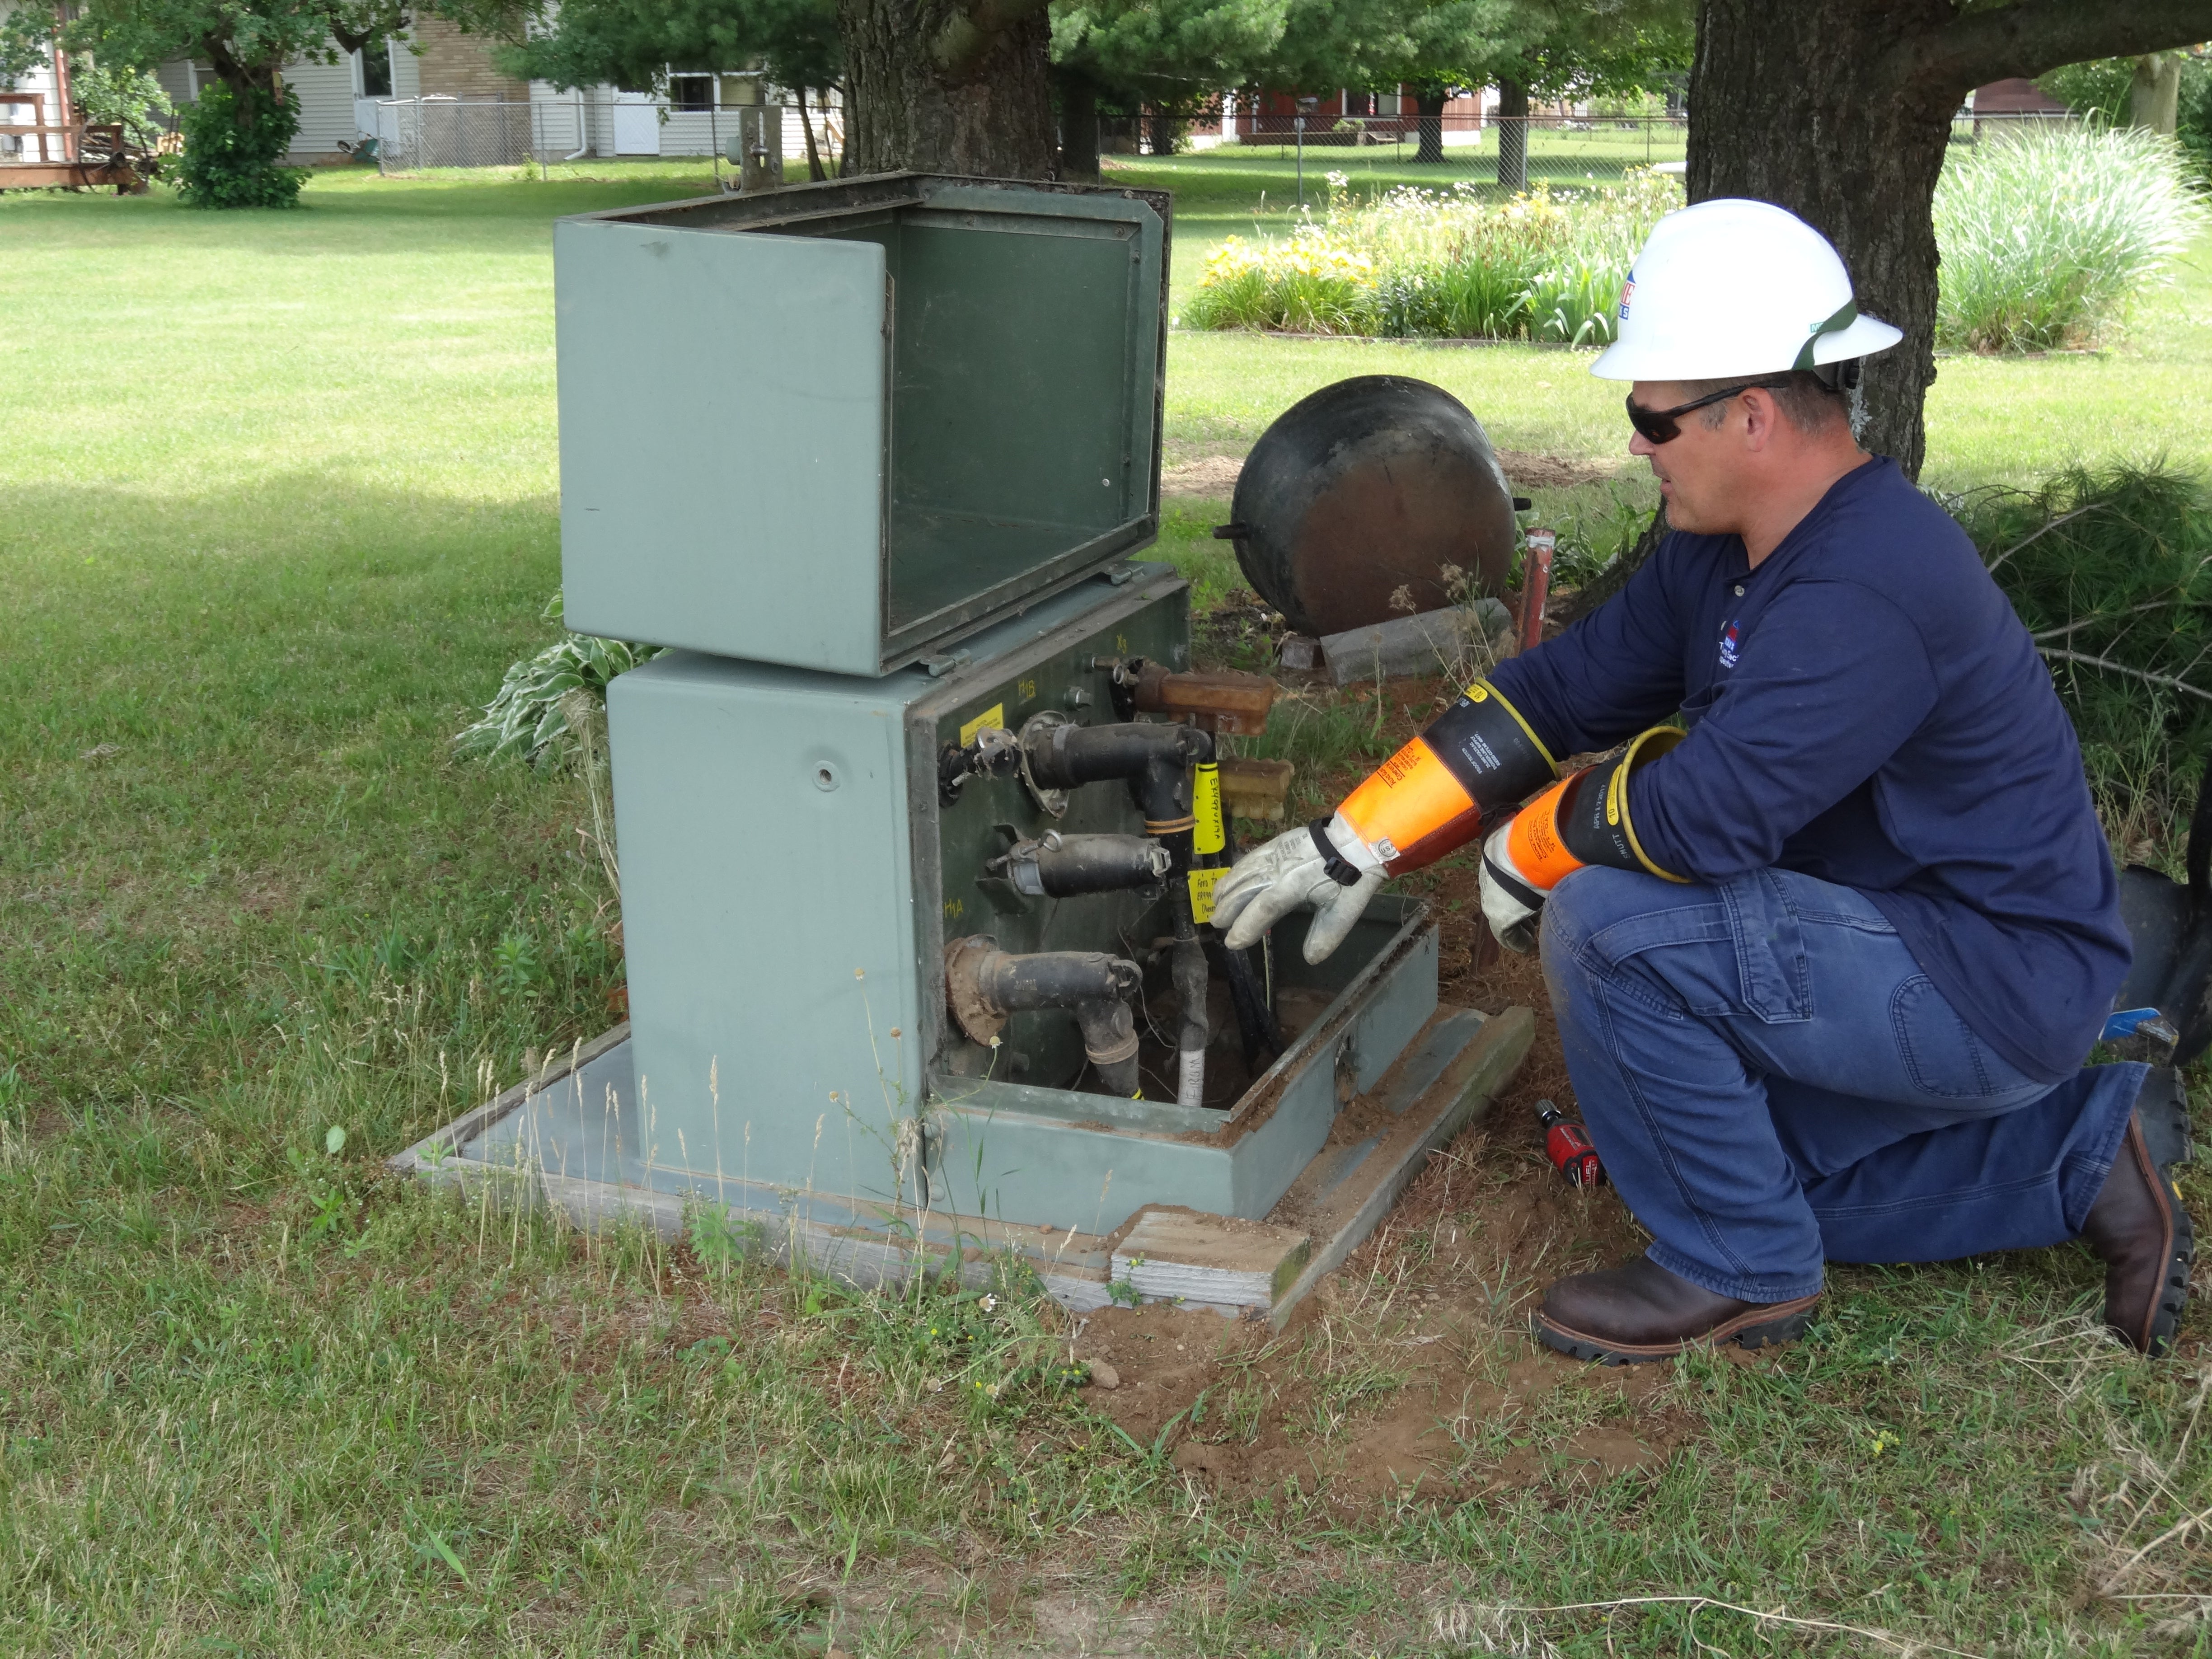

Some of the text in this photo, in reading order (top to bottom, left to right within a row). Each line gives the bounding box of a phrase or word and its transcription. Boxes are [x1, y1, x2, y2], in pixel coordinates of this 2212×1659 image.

[1472, 761, 1482, 774] PROOF
[1598, 785, 1606, 801] 2017
[1608, 808, 1615, 818] 10
